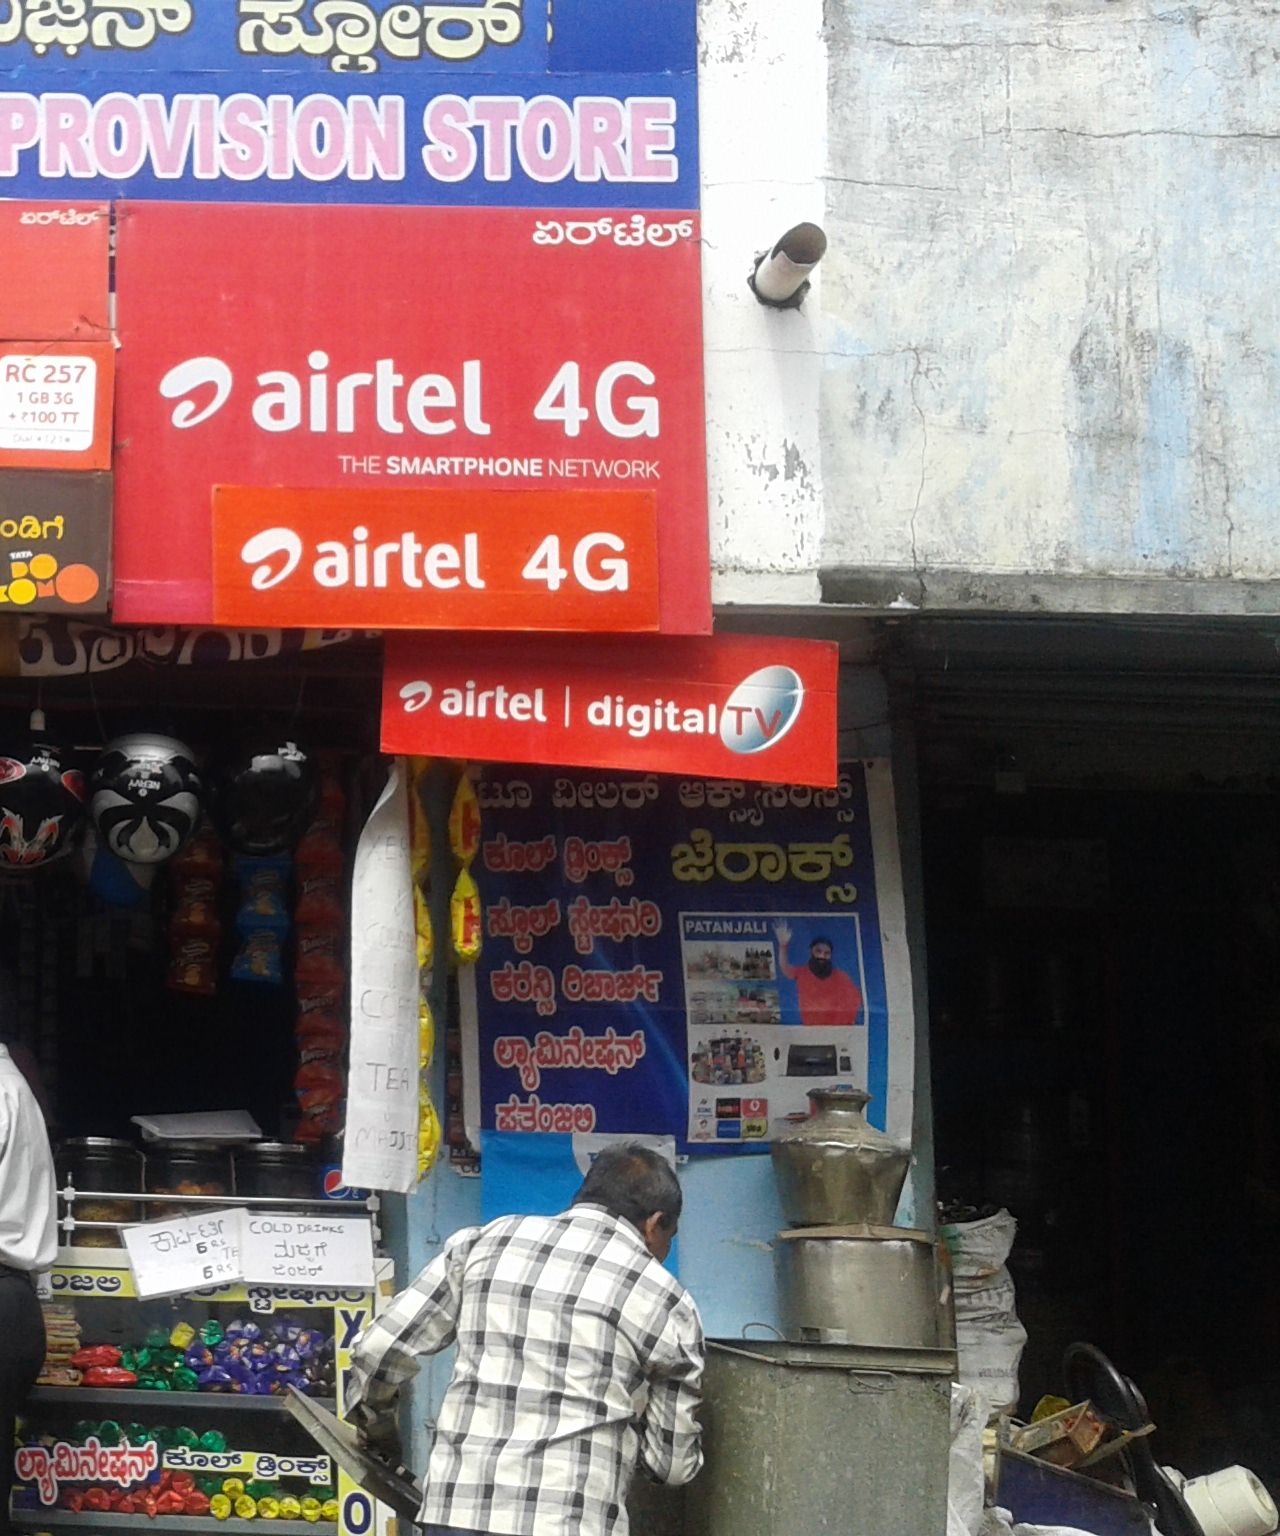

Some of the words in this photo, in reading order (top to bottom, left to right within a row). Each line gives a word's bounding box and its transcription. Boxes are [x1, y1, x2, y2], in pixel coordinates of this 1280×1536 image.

[421, 95, 679, 184] STORE
[5, 364, 37, 384] RC
[43, 365, 87, 384] 257
[17, 391, 25, 404] 1
[28, 391, 51, 405] GB
[53, 391, 74, 406] 3G
[252, 350, 491, 435] airtel
[533, 360, 660, 438] 4G
[61, 411, 80, 424] TT
[339, 455, 381, 475] THE
[386, 456, 543, 477] SMARTPHONE
[548, 459, 662, 480] NETWORK
[313, 526, 485, 590] airtel
[522, 532, 630, 592] 4G
[439, 680, 547, 723] airtel
[586, 694, 717, 738] digital
[726, 705, 782, 739] TV
[685, 919, 767, 934] PATANJALI
[366, 1061, 409, 1092] TEA
[249, 1221, 292, 1235] COLD
[297, 1223, 344, 1235] DRINKS
